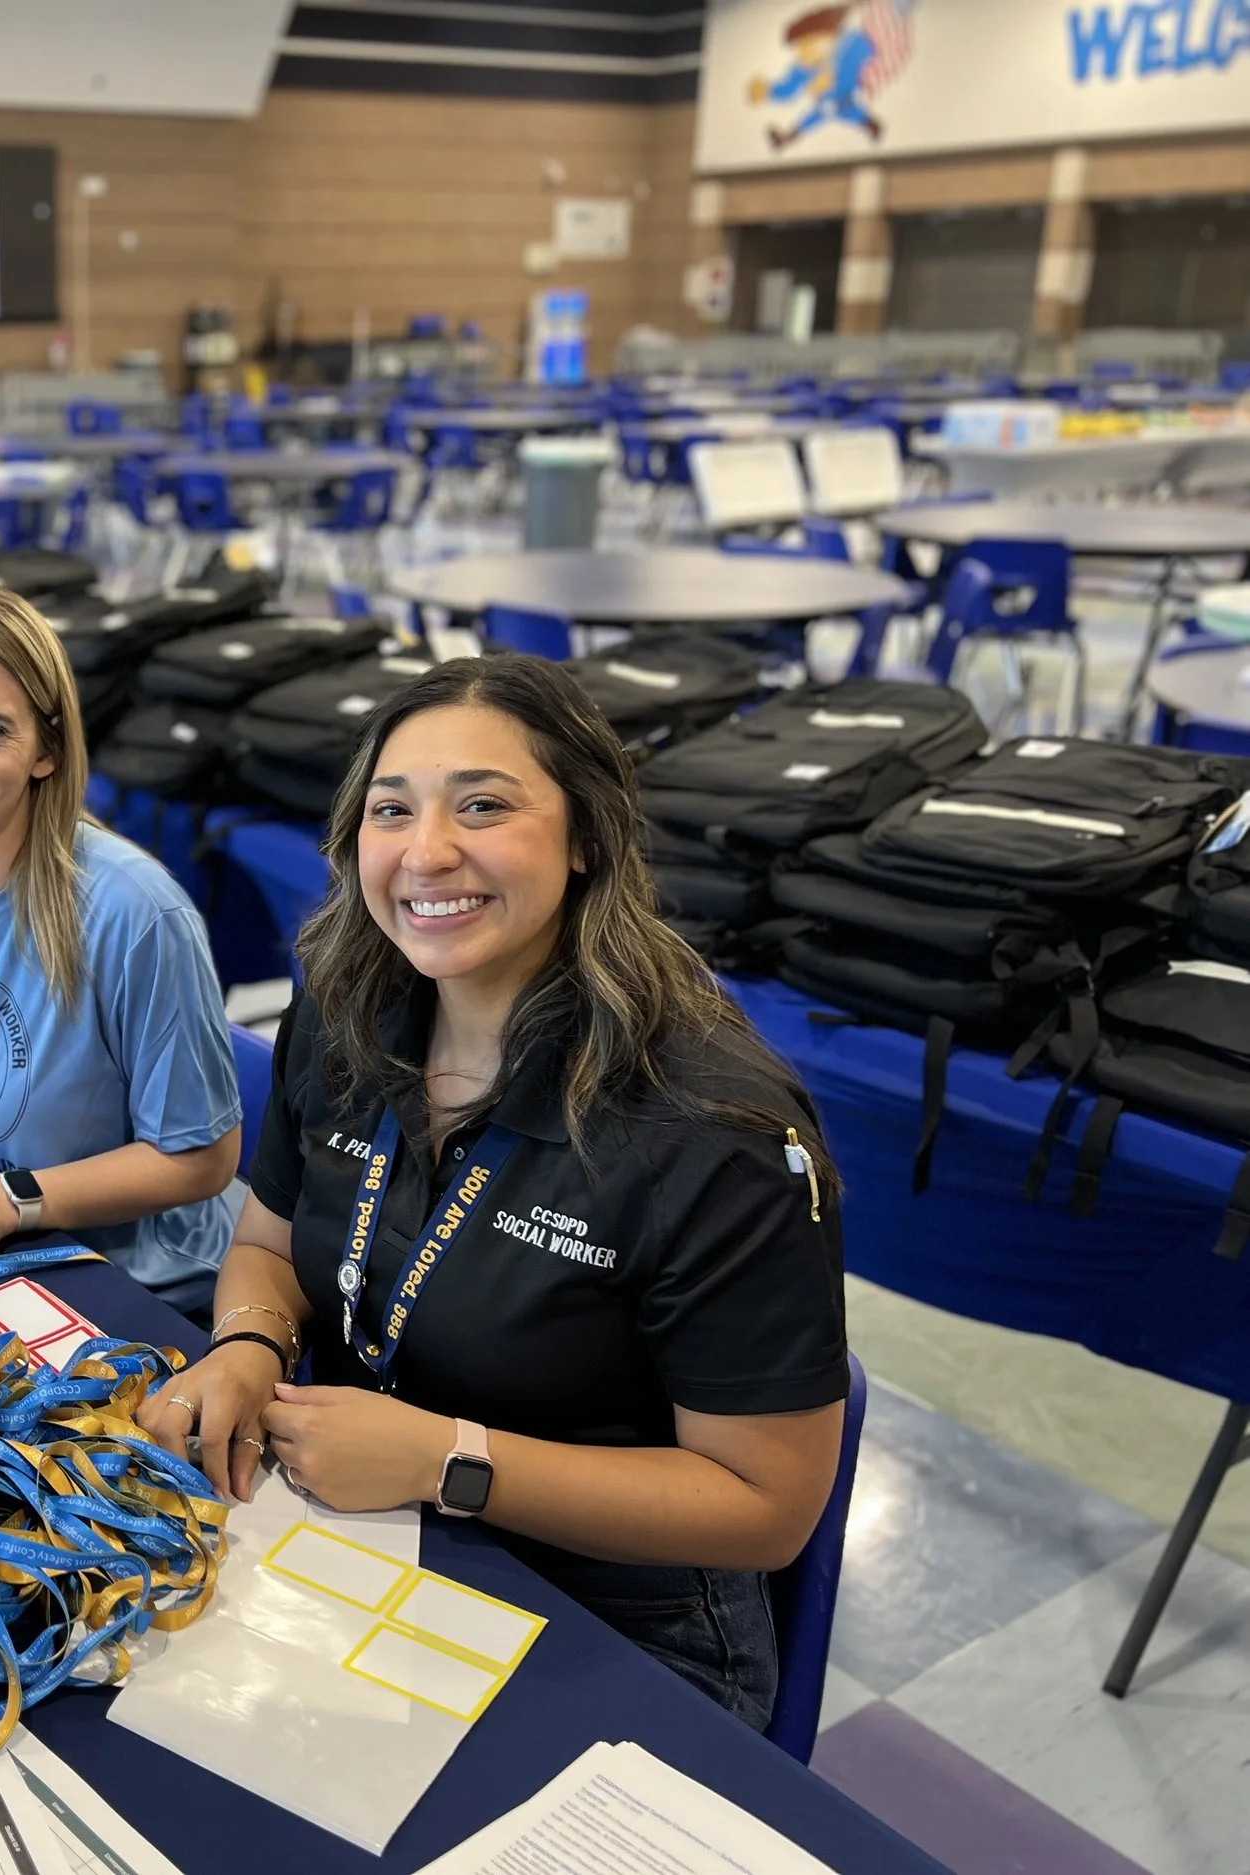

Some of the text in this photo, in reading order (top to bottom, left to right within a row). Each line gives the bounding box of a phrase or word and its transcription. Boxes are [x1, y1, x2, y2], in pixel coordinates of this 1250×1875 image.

[326, 1132, 342, 1150] K.
[364, 1152, 388, 1191] 988
[530, 1204, 589, 1238] CCSDPD
[492, 1210, 618, 1270] SOCIAL WORKER
[20, 1251, 47, 1262] Safety
[386, 1302, 409, 1341] 988
[38, 1384, 81, 1397] CCSDPD
[144, 1445, 175, 1469] Safety
[58, 1496, 116, 1519] Conference
[116, 1513, 151, 1526] Safety
[36, 1548, 72, 1565] Safety
